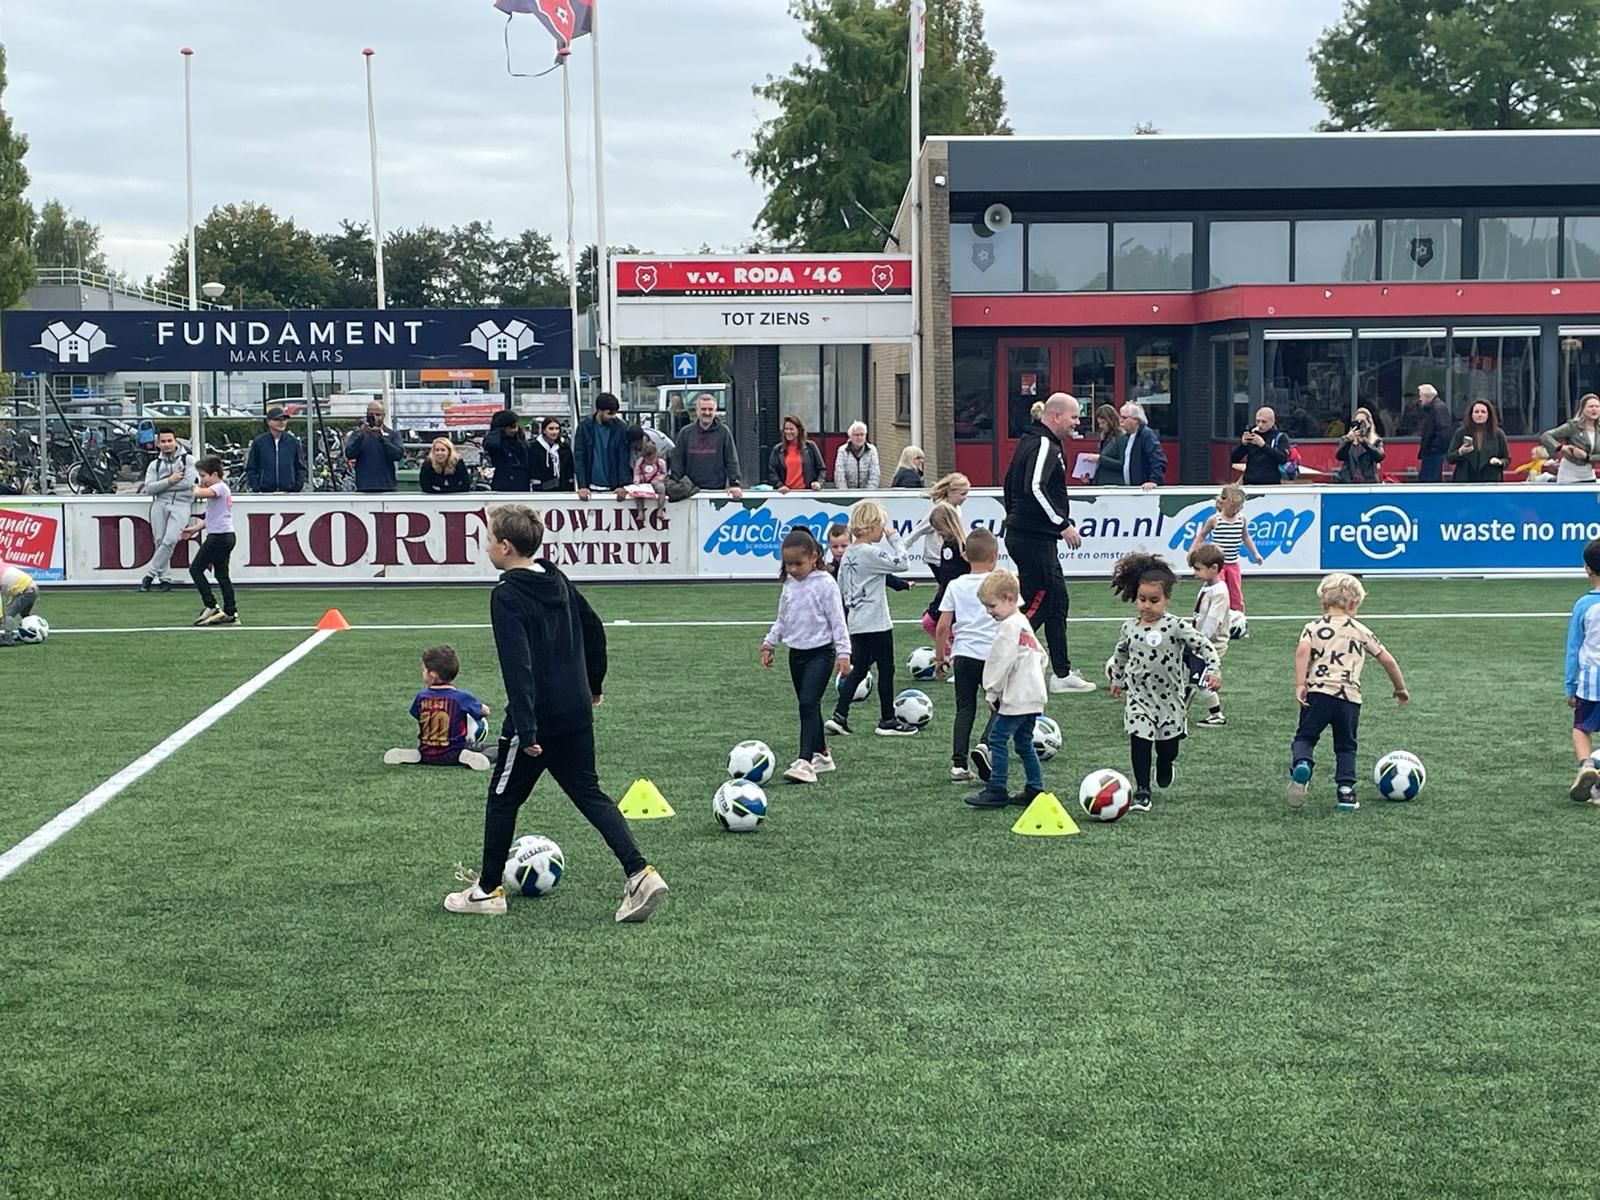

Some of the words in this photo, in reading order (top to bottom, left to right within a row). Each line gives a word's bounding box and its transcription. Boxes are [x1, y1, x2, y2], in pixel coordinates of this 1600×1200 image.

[686, 271, 726, 284] v.v.
[733, 267, 795, 283] RODA
[721, 312, 753, 326] TOT
[759, 311, 810, 326] ZIENS
[157, 321, 423, 346] FUNDAMENT
[230, 349, 344, 363] MAKELAARS
[543, 508, 670, 532] OWLING
[1329, 518, 1419, 543] renewi
[1440, 519, 1516, 542] waste
[1522, 522, 1555, 542] no
[16, 537, 25, 548] u
[244, 507, 488, 567] KORF
[718, 519, 835, 549] succlen!
[543, 541, 671, 565] ENTRUM
